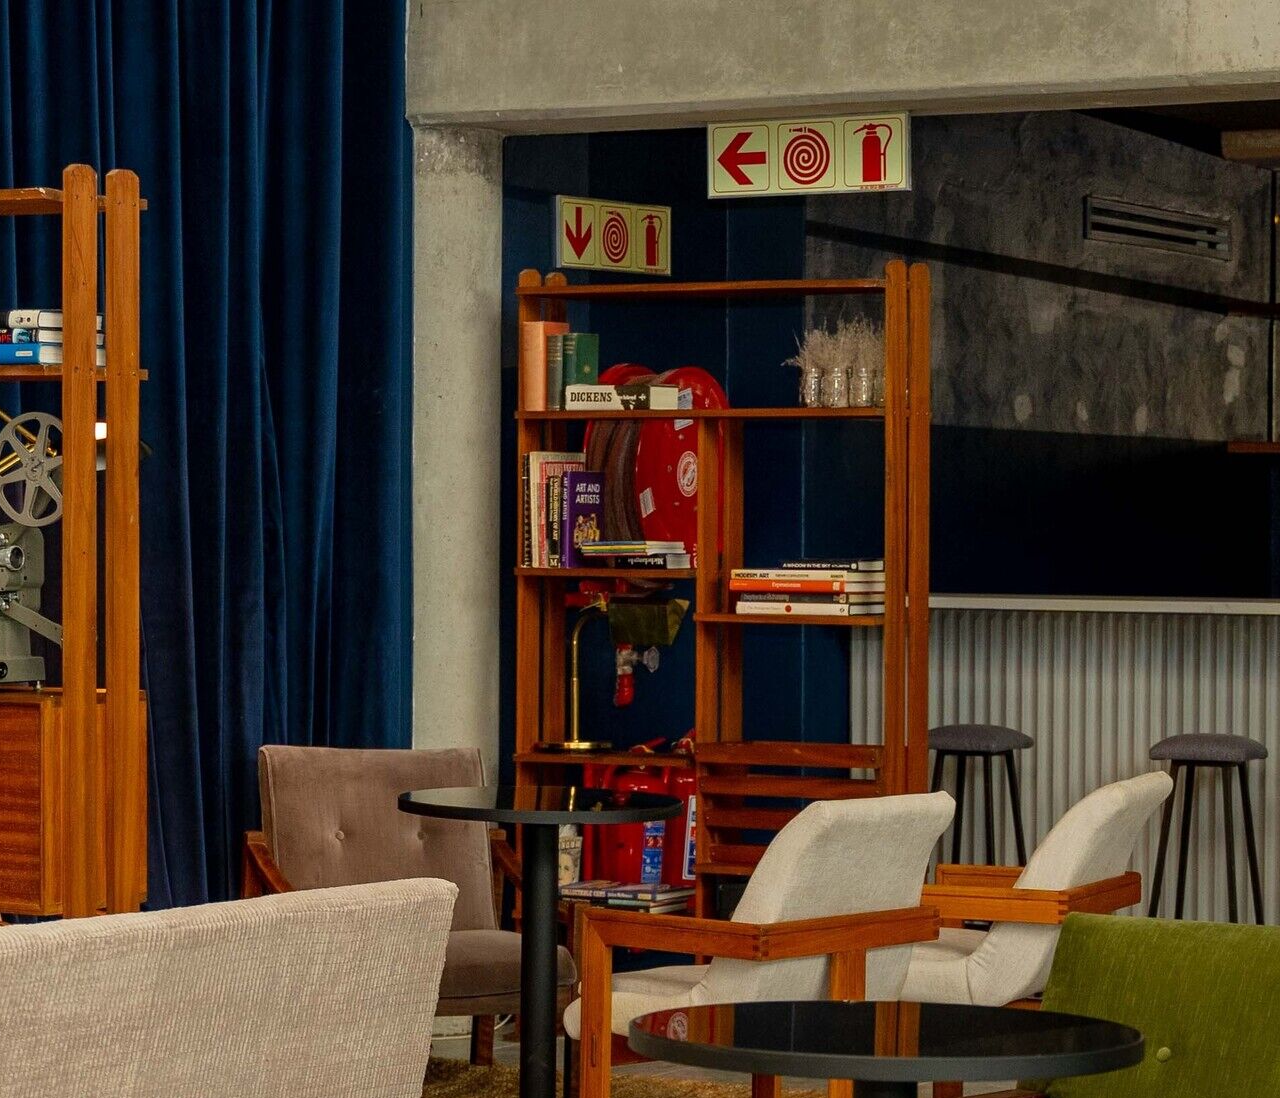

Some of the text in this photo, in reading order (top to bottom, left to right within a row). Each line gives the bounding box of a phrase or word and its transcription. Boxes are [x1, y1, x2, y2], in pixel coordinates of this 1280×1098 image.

[570, 392, 613, 402] DICKENS
[576, 483, 600, 493] ART AND
[575, 494, 600, 504] ARTISTS
